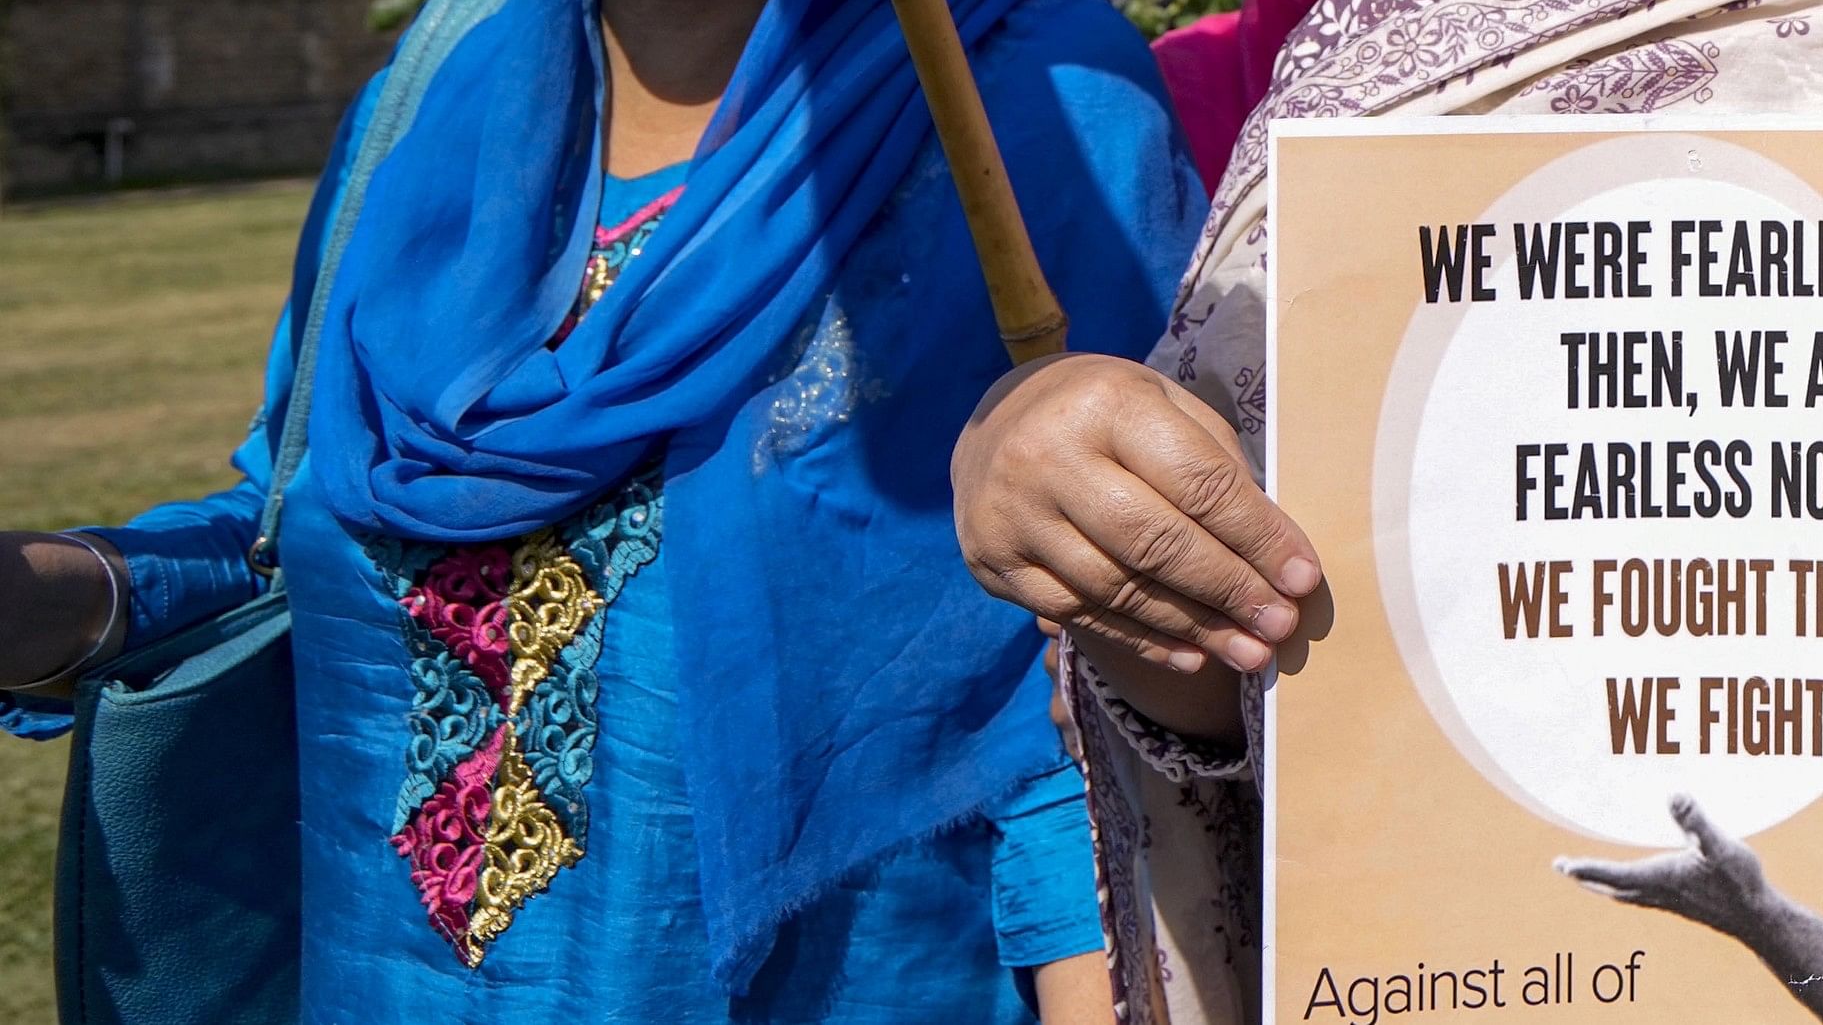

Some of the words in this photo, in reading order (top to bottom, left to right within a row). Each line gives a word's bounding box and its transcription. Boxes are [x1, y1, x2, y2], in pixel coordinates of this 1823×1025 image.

[1419, 224, 1496, 303] WE
[1514, 221, 1652, 300] WERE
[1561, 331, 1697, 417] THEN,
[1715, 331, 1788, 407] WE
[1516, 440, 1752, 521] FEARLESS
[1498, 561, 1573, 639] WE
[1593, 558, 1774, 637] FOUGHT
[1606, 677, 1680, 754] WE
[1304, 960, 1505, 1025] Against
[1523, 953, 1572, 1005] all
[1593, 951, 1645, 1003] of
